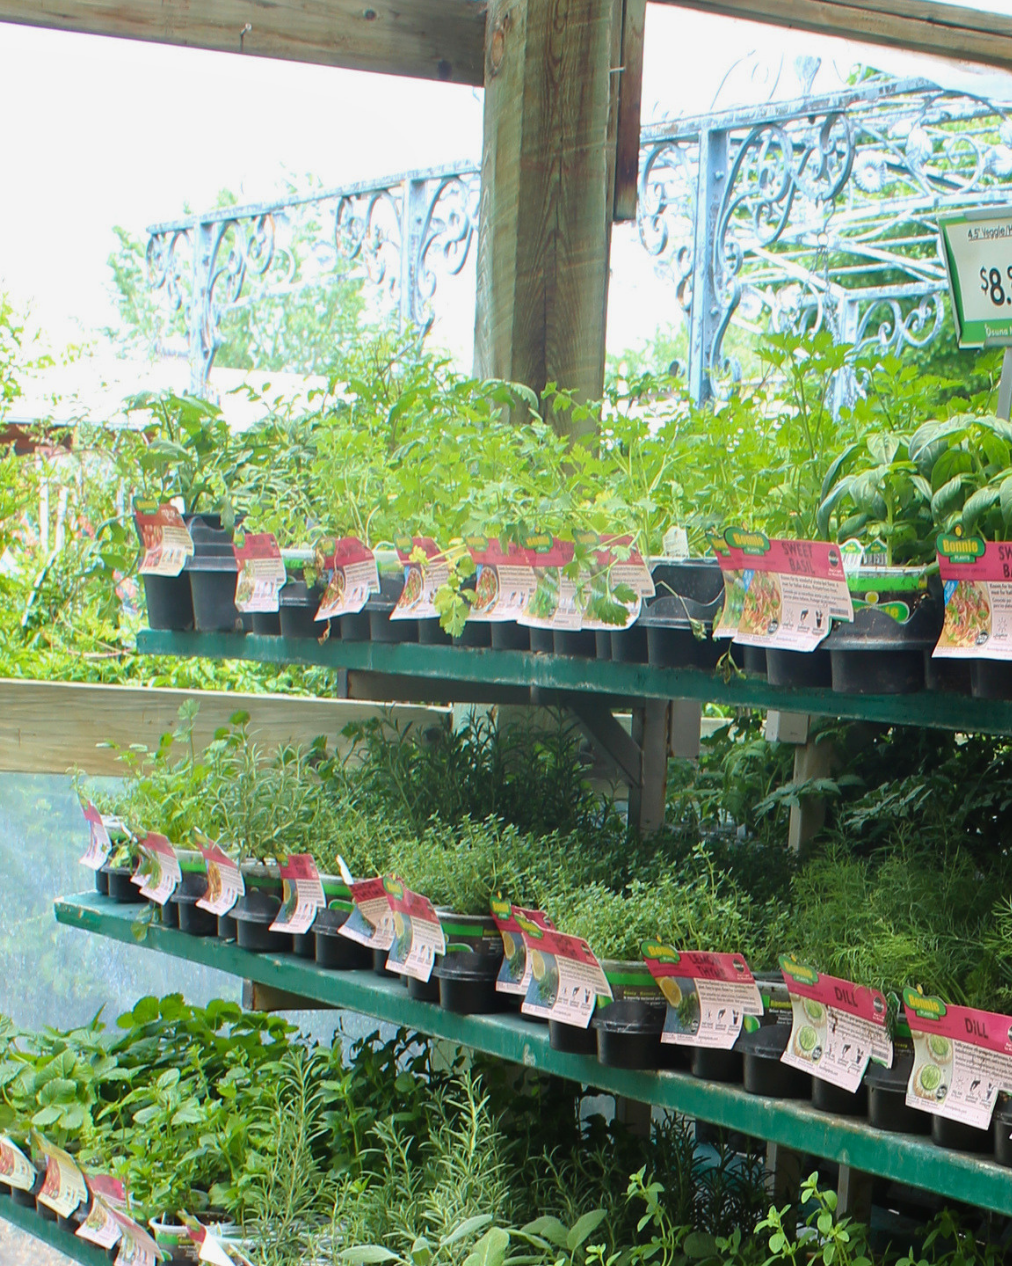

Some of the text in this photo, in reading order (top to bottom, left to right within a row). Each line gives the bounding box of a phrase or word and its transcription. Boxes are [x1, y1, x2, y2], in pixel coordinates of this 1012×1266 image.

[781, 542, 813, 558] SWEET
[943, 538, 978, 554] Bonnie
[789, 559, 816, 574] BASIL
[834, 986, 859, 1008] DILL
[964, 1017, 989, 1039] DILL
